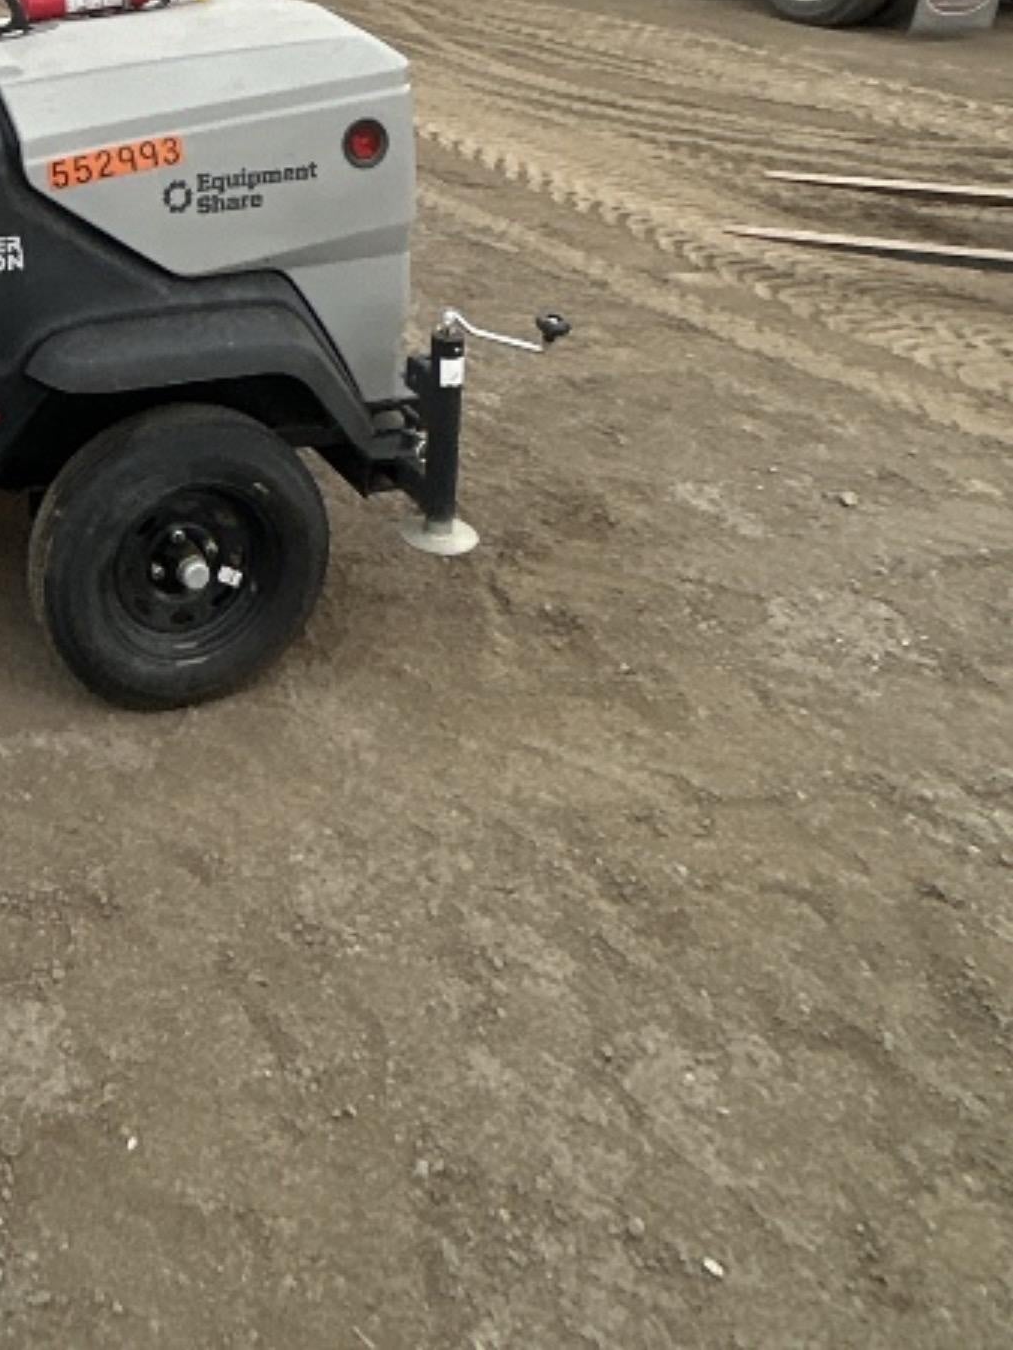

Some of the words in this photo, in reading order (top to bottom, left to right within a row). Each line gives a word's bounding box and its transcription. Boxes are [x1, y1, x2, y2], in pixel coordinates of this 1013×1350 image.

[50, 137, 182, 189] 552993
[195, 161, 319, 194] Equipment
[195, 192, 264, 214] Share
